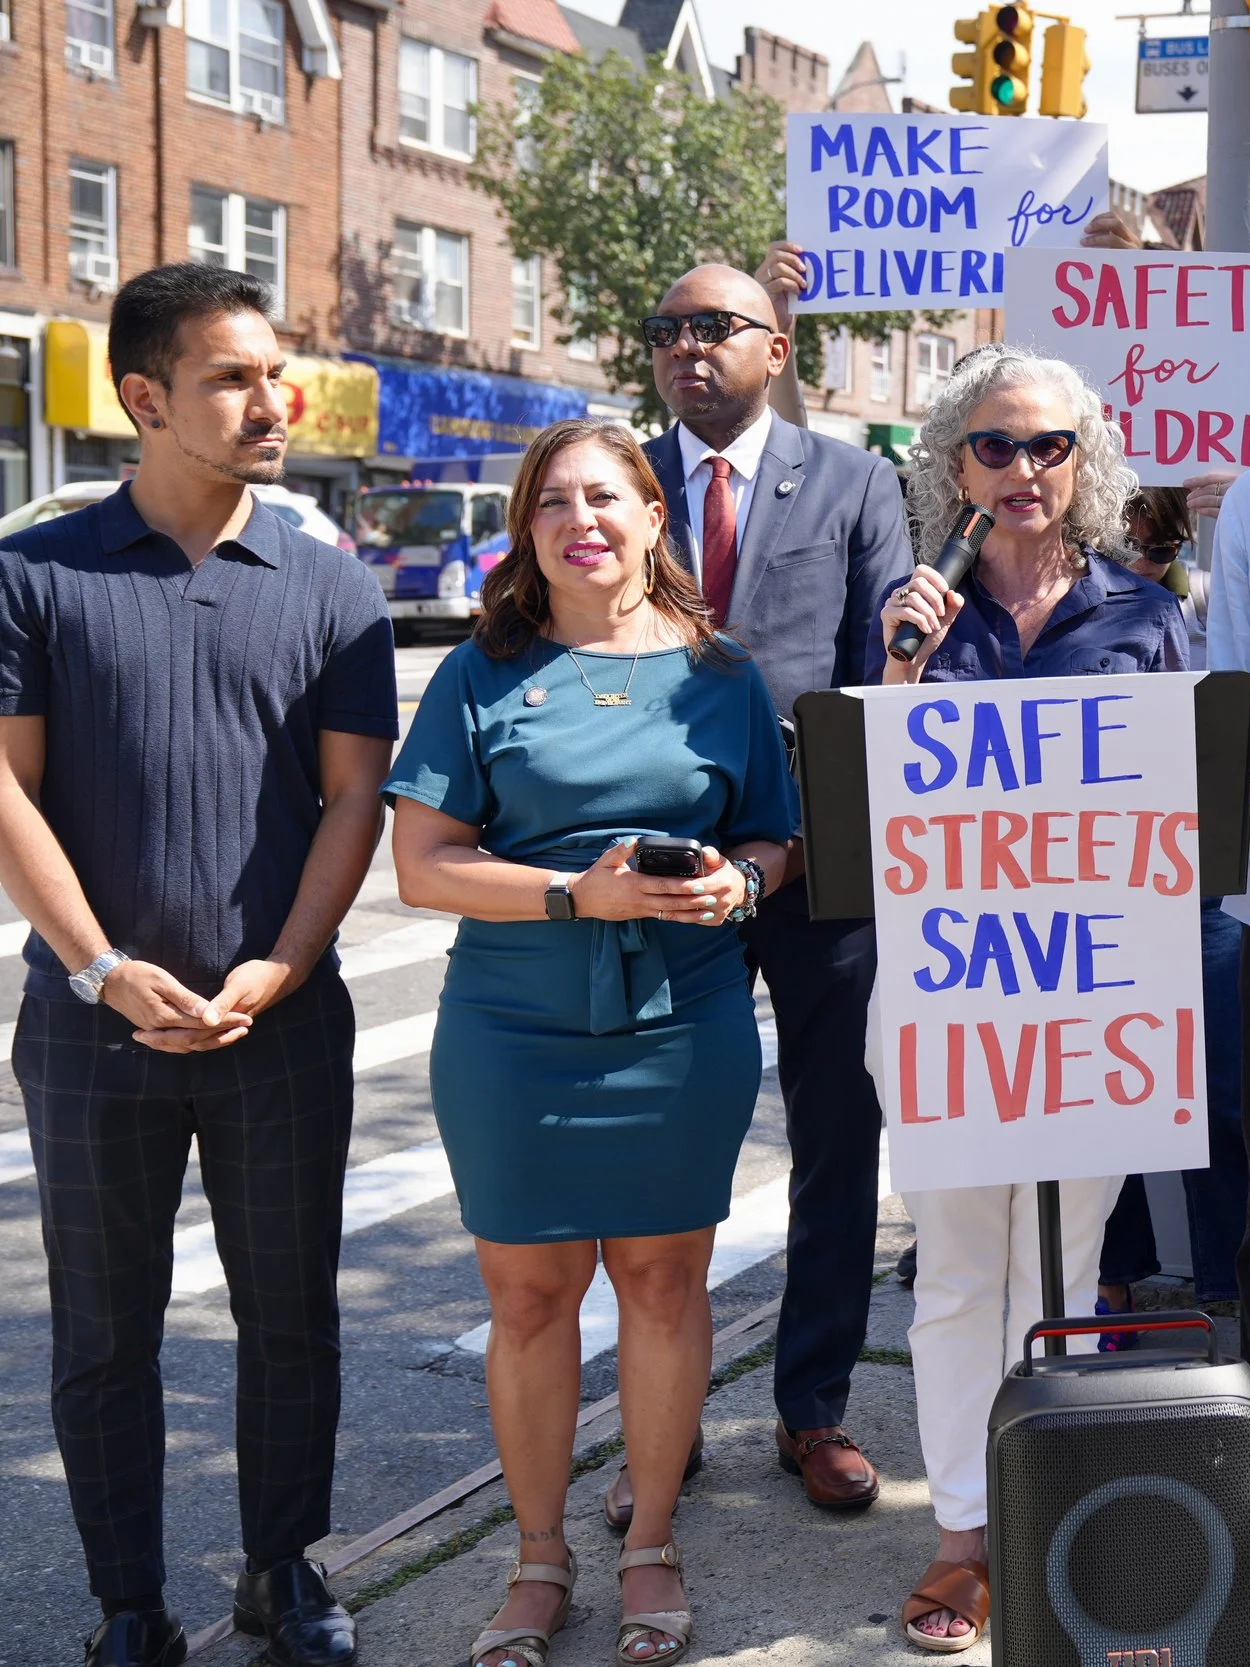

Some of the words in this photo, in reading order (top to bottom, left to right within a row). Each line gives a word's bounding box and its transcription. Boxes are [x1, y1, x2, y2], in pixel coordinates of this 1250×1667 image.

[1143, 61, 1190, 77] BUSES
[1165, 41, 1194, 55] BUS
[810, 123, 989, 178] MAKE
[827, 184, 977, 233] ROOM
[1008, 190, 1093, 246] for
[1107, 343, 1220, 407] for
[903, 695, 1143, 794] SAFE
[884, 810, 1199, 896] STREETS
[913, 907, 1136, 996] SAVE
[899, 1007, 1195, 1126] LIVES!
